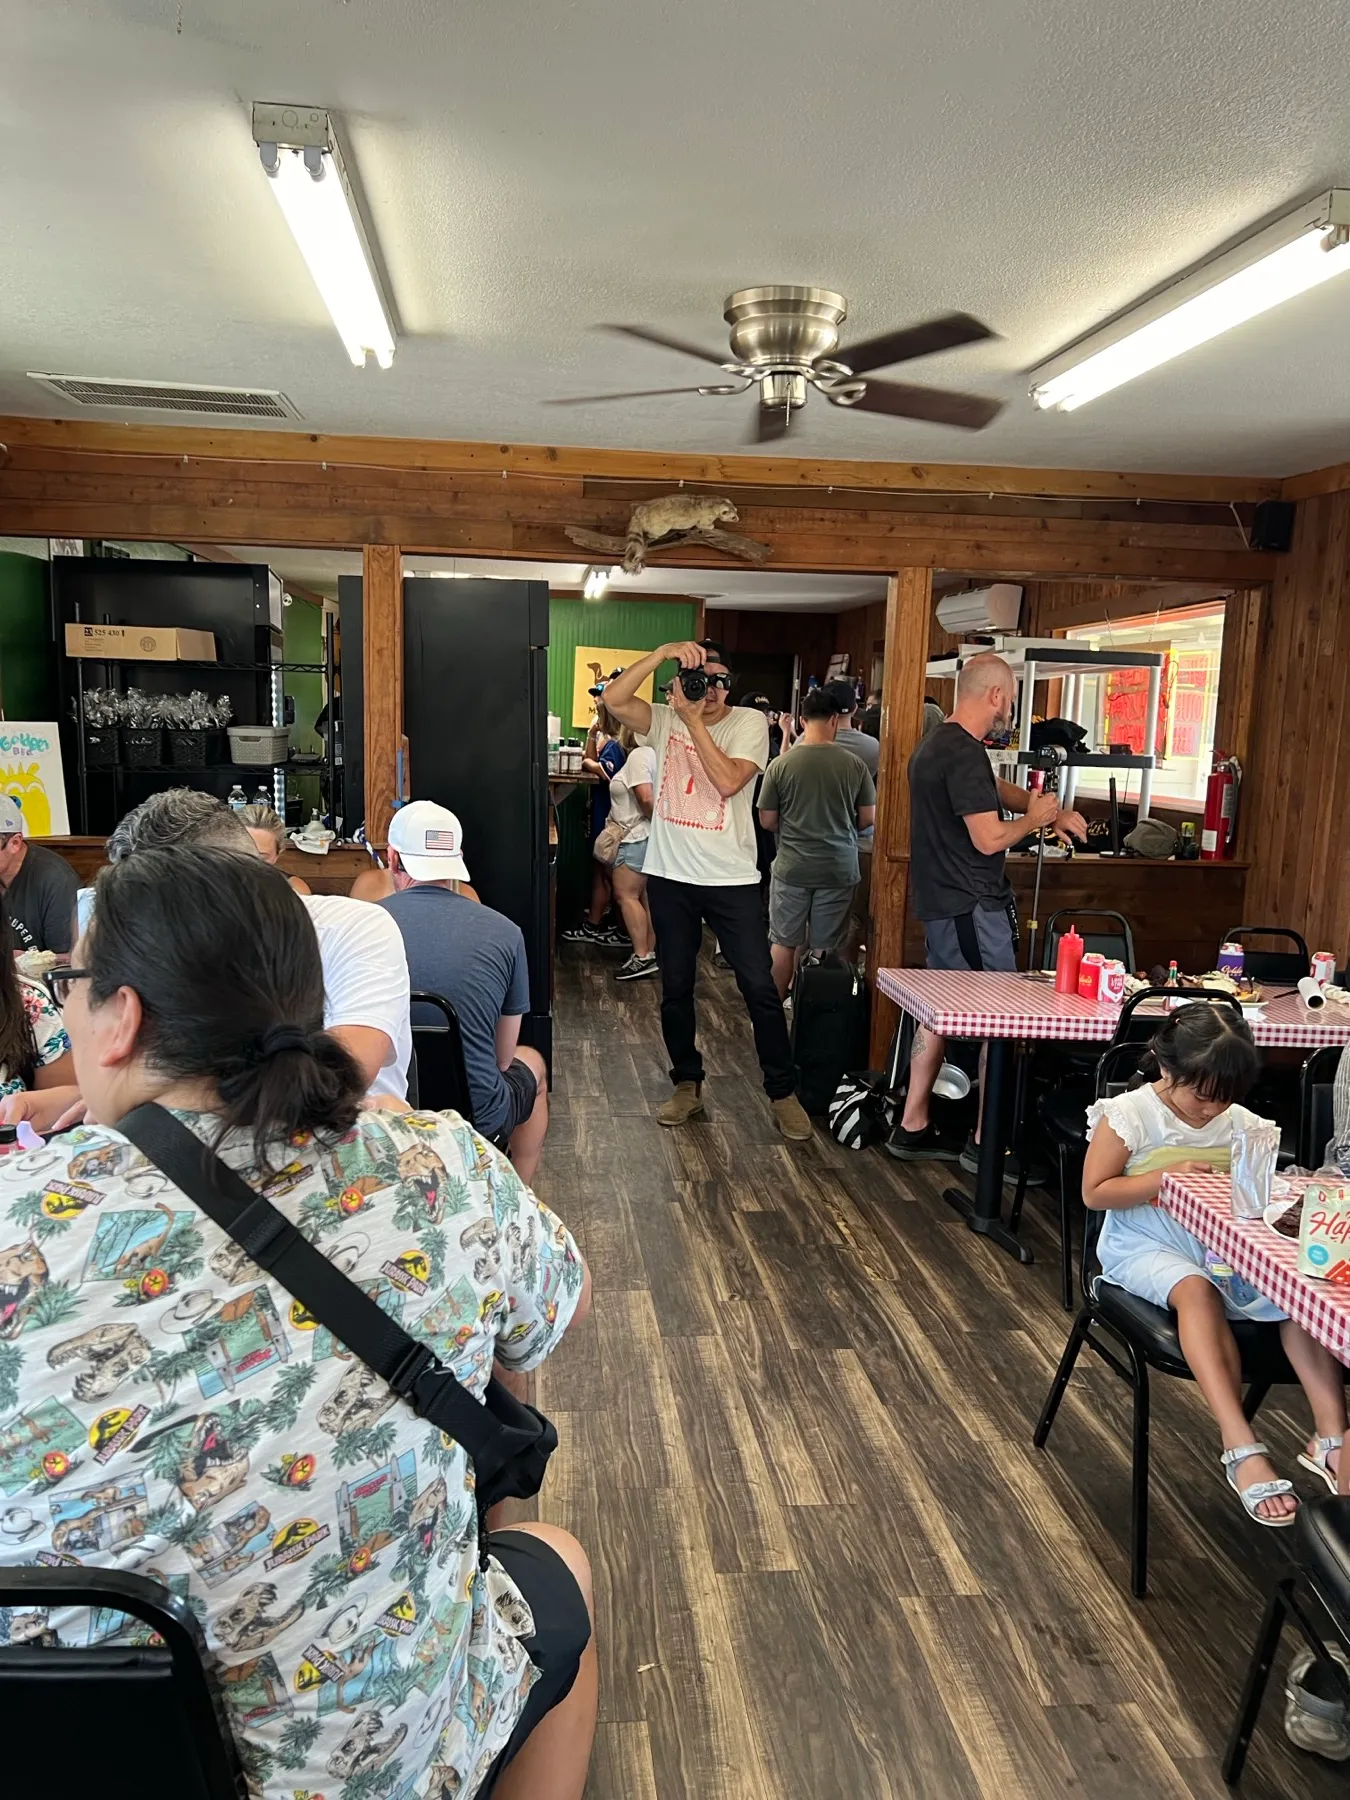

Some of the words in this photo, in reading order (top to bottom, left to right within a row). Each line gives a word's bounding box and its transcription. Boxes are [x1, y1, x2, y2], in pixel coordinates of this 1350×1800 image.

[9, 916, 33, 943] UPER
[380, 1262, 411, 1285] JURASSIC
[406, 1277, 427, 1296] PARK
[96, 1427, 130, 1464] JURASSIC
[123, 1405, 149, 1432] PARK
[266, 1541, 304, 1570] JURASSIC
[302, 1526, 329, 1548] PARK
